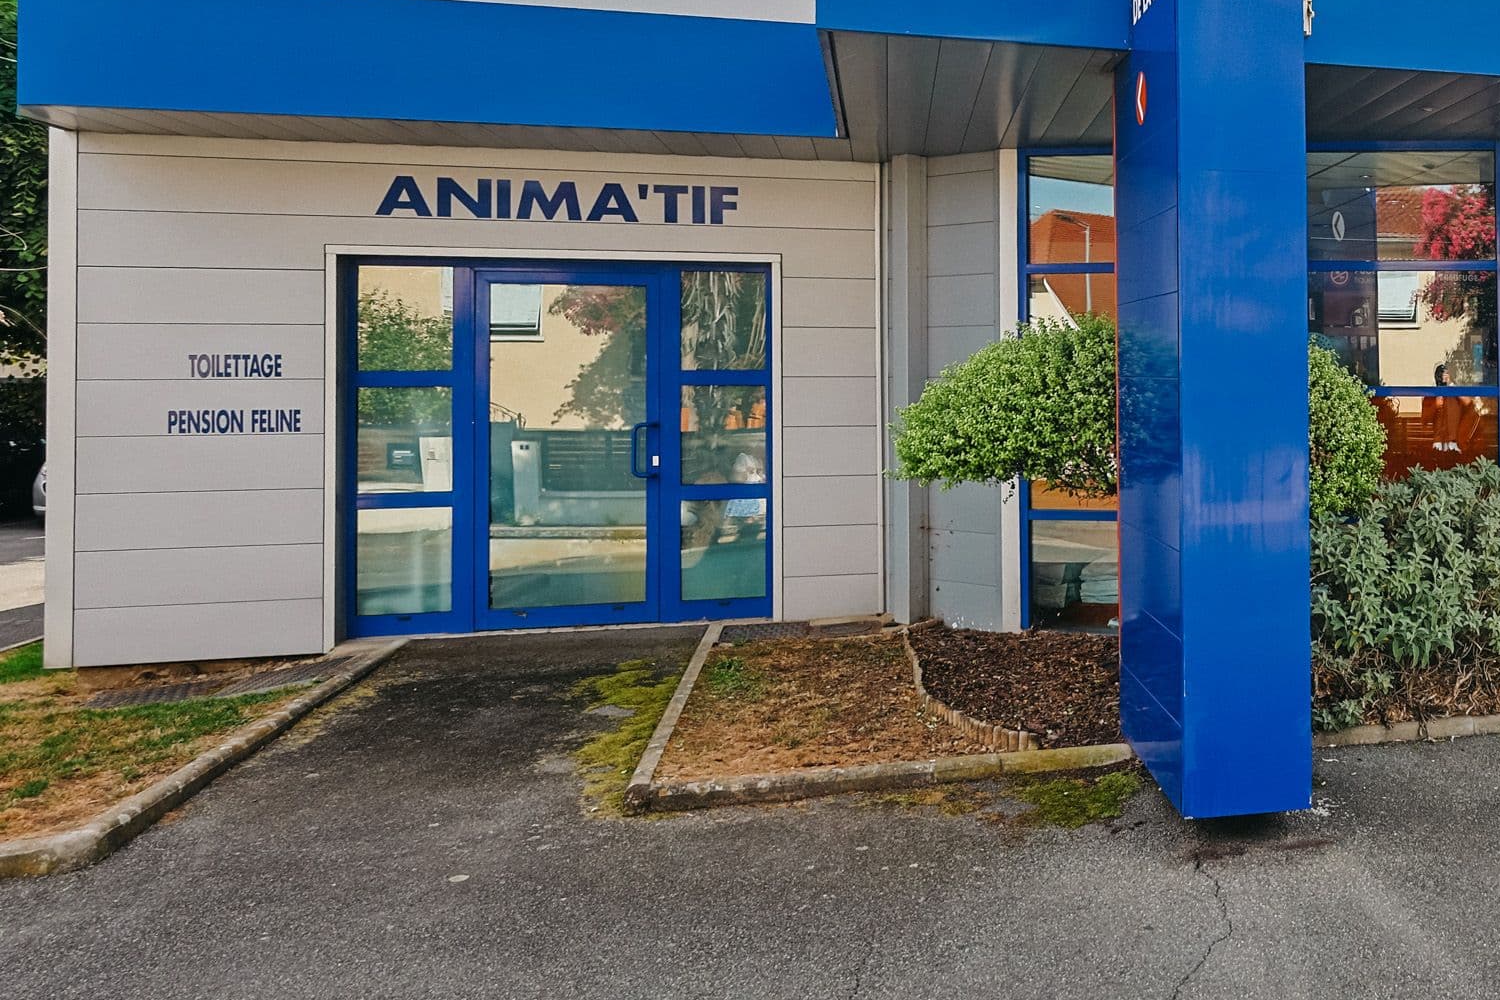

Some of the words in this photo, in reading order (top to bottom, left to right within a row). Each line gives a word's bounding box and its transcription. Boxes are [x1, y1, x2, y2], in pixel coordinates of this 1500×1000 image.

[375, 175, 739, 225] ANIMA'TIF
[188, 353, 283, 378] TOILETTAGE
[168, 409, 244, 434] PENSION
[251, 409, 301, 433] FELINE
